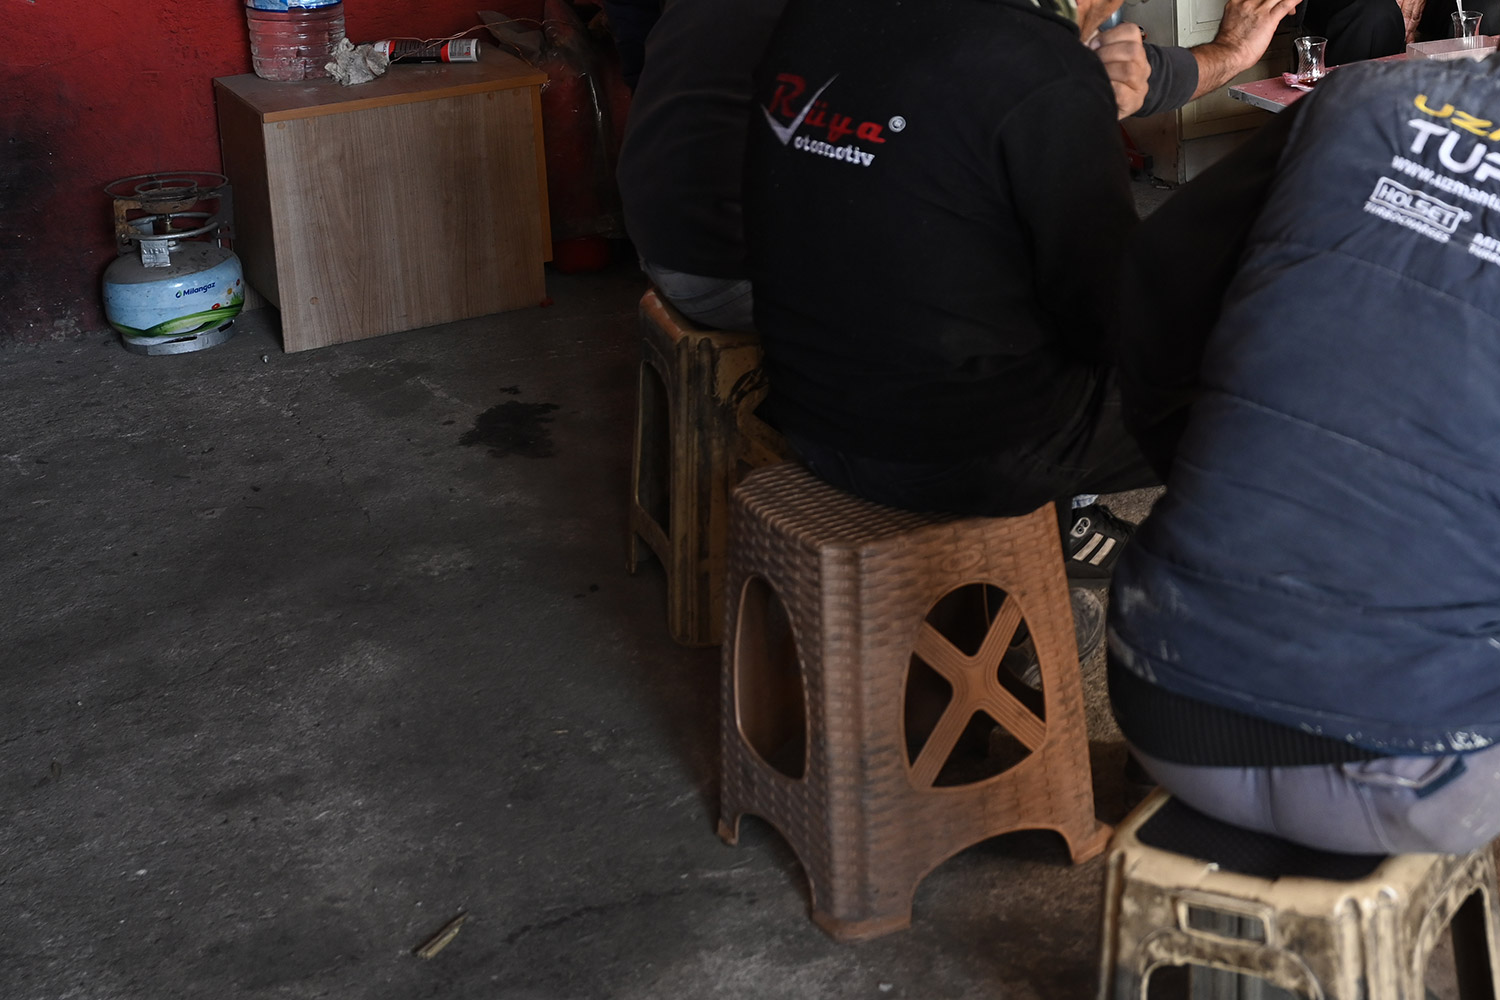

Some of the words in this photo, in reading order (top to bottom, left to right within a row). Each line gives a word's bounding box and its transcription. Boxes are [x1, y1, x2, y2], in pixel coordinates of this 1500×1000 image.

[769, 73, 886, 144] Rüya
[794, 134, 875, 167] otomotiv
[1379, 184, 1456, 226] HOLSET
[183, 282, 216, 296] Milangaz
